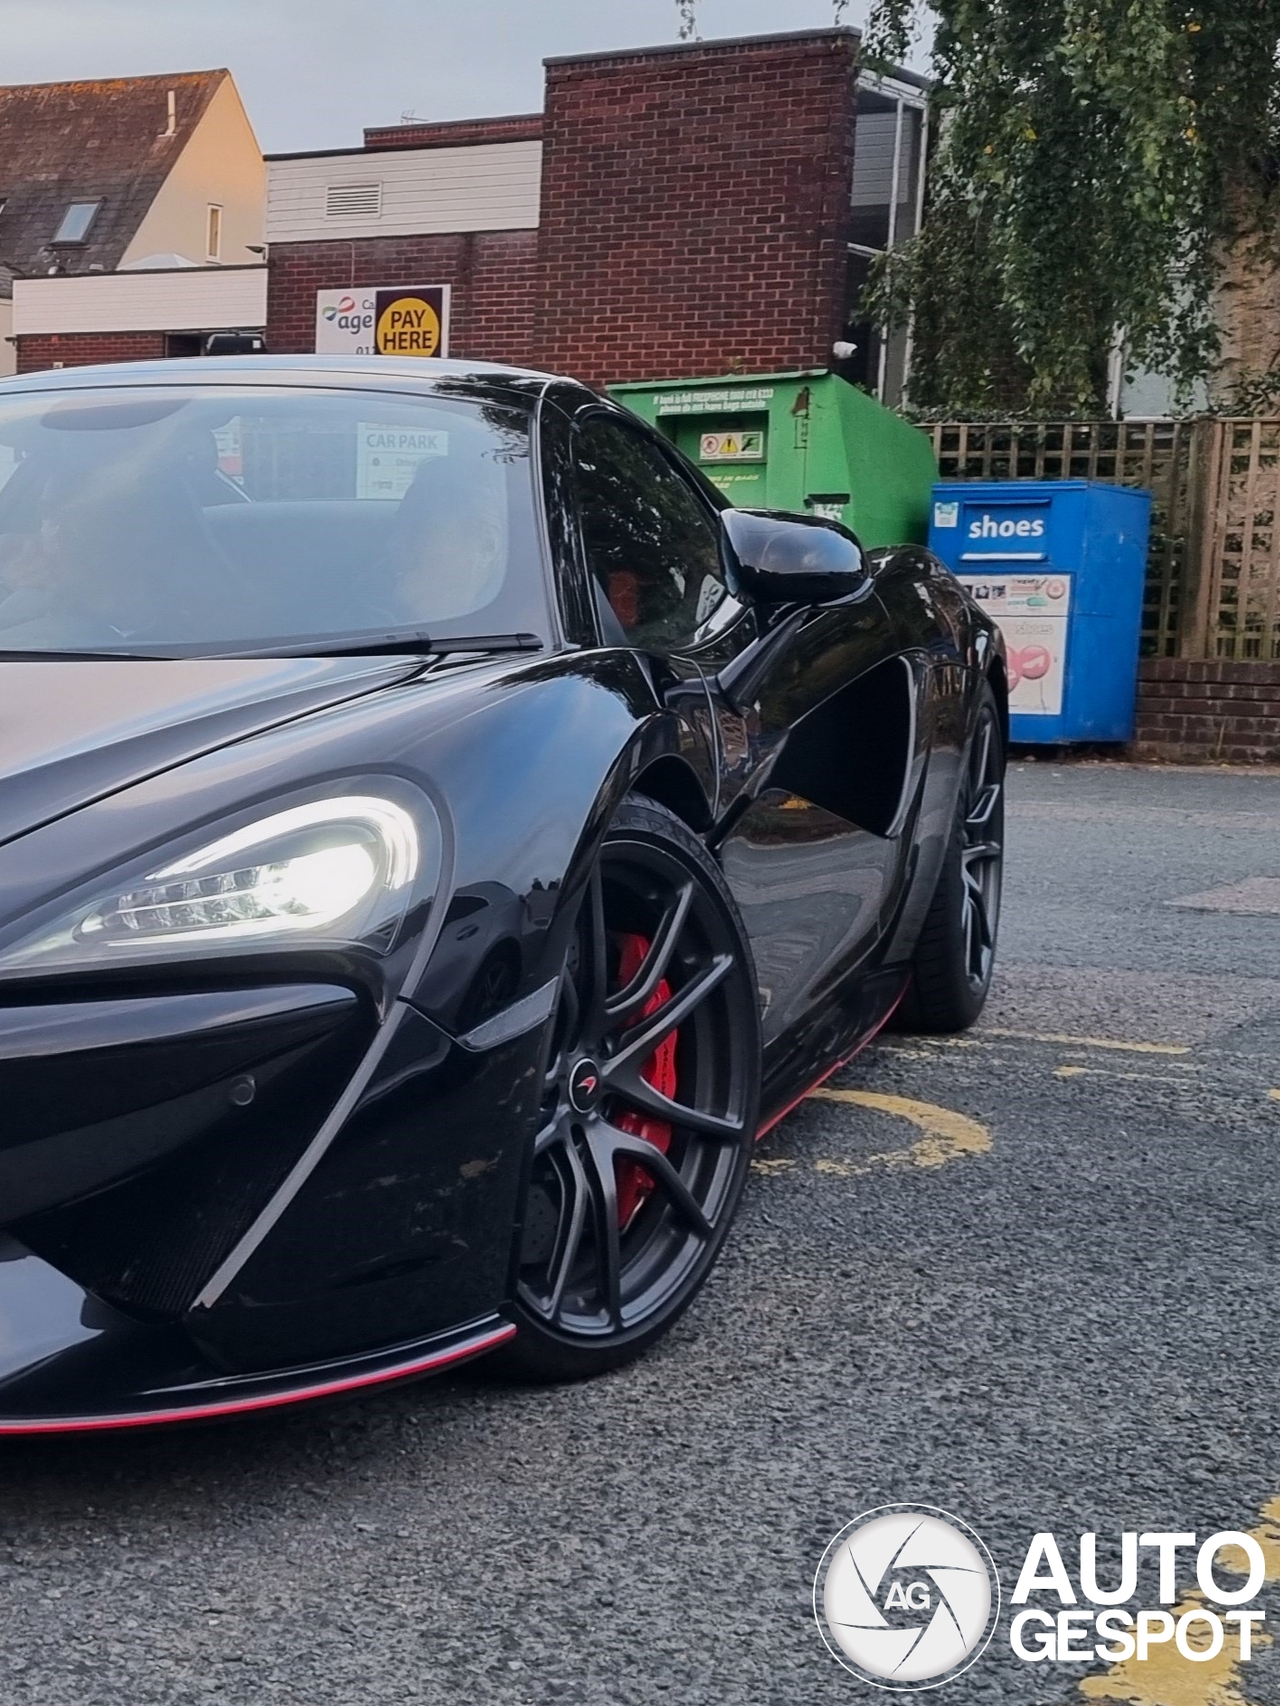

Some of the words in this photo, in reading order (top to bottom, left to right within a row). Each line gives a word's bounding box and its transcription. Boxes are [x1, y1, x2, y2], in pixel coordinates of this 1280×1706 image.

[337, 314, 373, 335] age
[391, 309, 426, 329] PAY
[383, 330, 432, 351] HERE
[366, 433, 396, 448] CAR
[398, 434, 438, 449] PARK
[968, 514, 1044, 539] shoes
